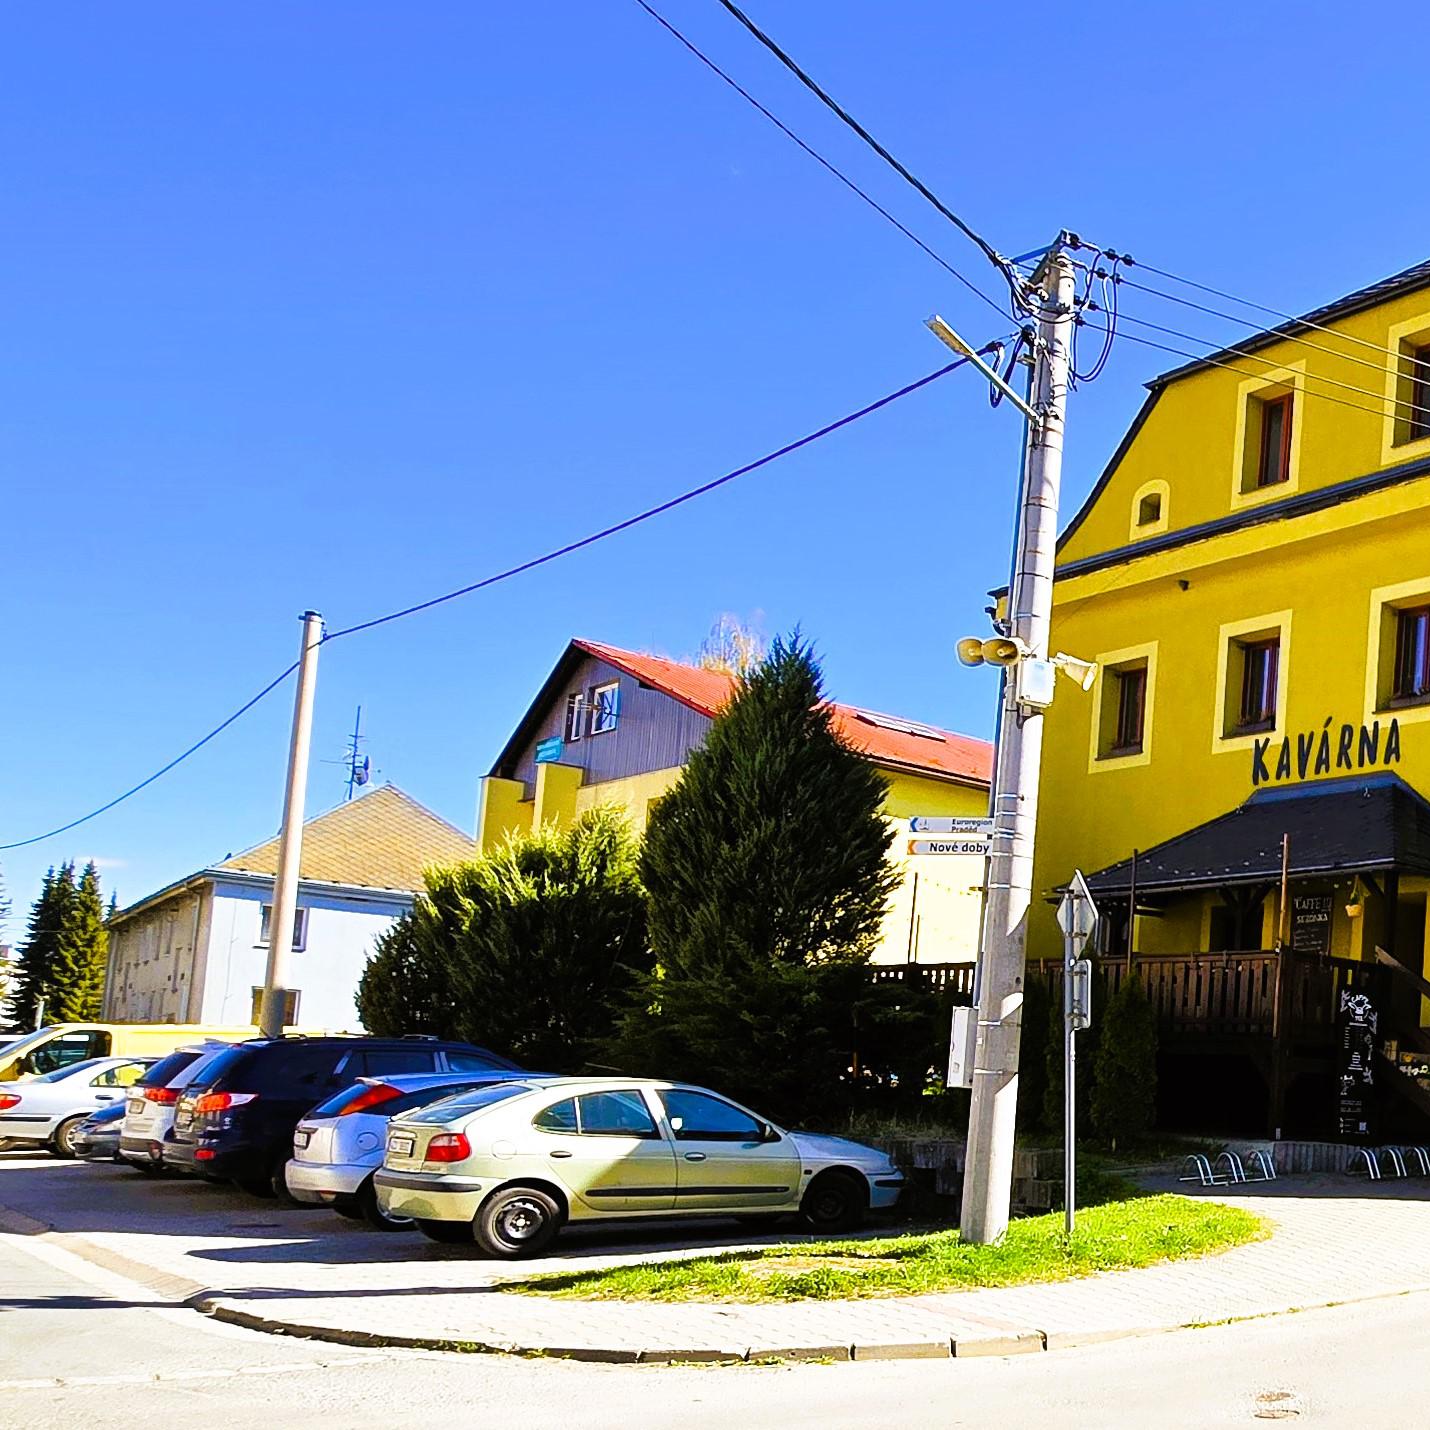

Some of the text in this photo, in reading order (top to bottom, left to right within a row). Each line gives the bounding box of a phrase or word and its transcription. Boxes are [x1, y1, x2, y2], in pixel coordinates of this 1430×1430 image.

[1252, 716, 1400, 785] KAVÁRNA
[951, 818, 993, 827] Euroregion
[929, 841, 990, 855] Nové doby
